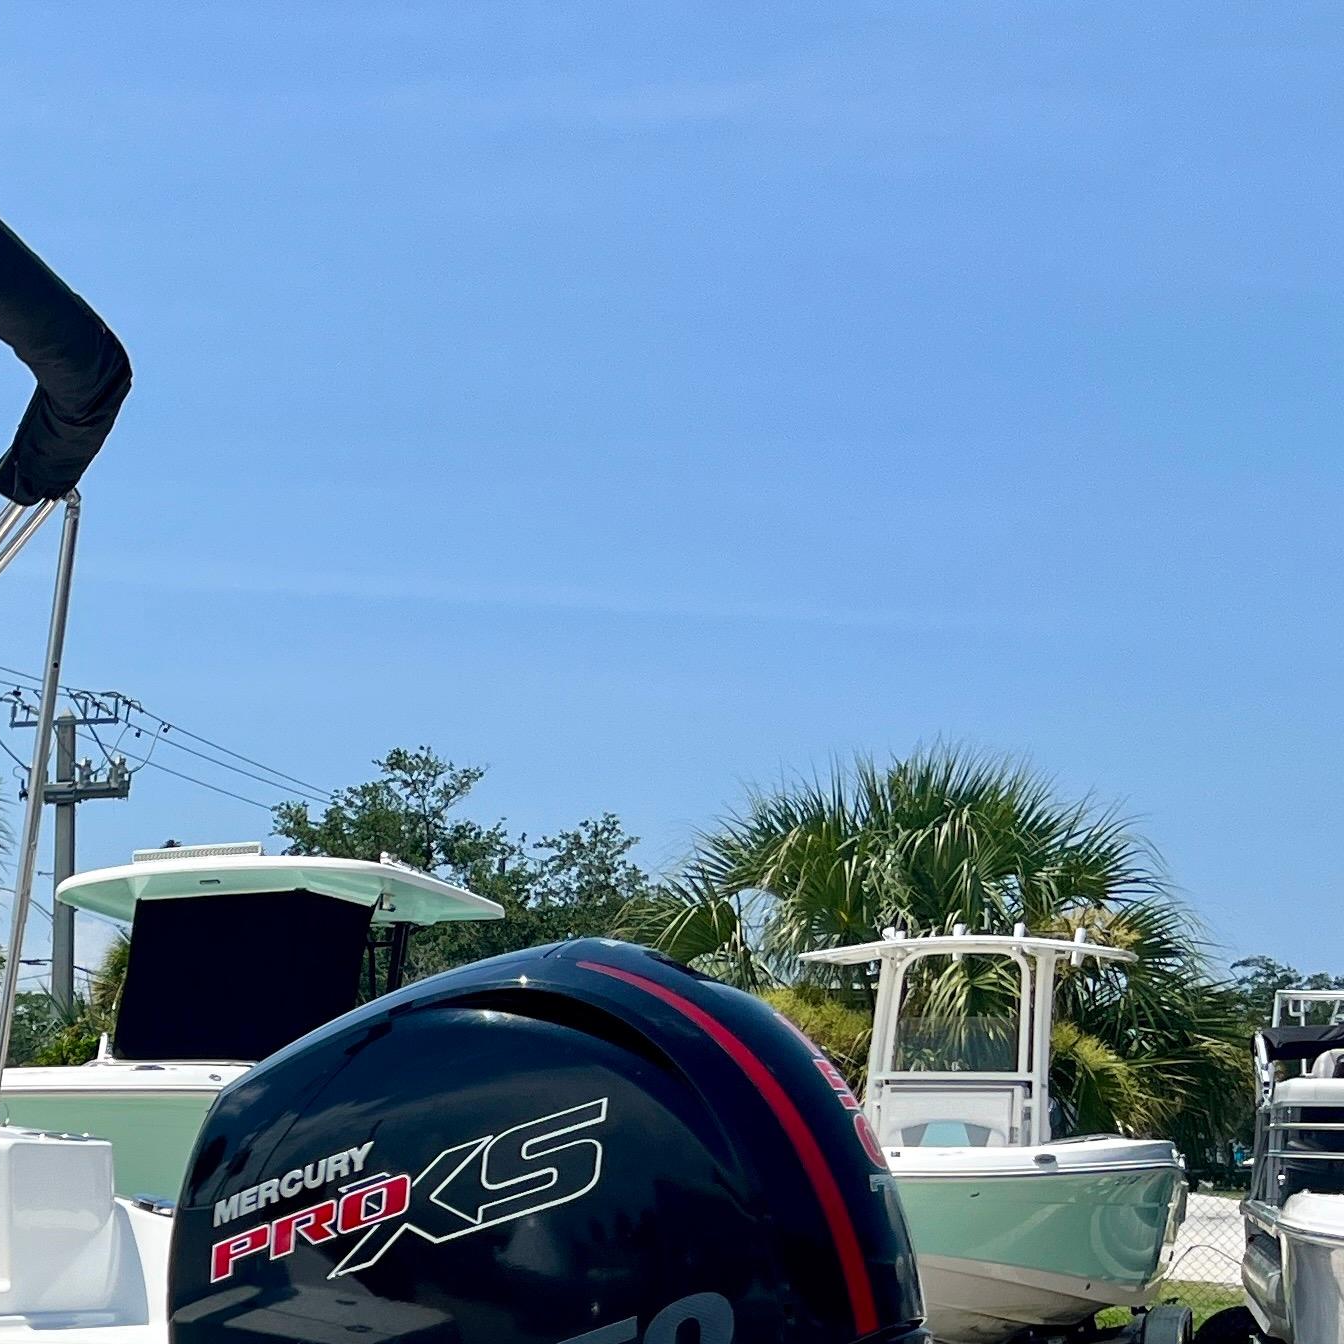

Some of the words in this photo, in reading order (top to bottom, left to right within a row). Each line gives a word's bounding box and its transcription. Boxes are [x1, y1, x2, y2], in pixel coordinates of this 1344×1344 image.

[210, 1174, 412, 1283] PRO
[327, 1097, 608, 1280] XS
[213, 1141, 374, 1227] MERCURY
